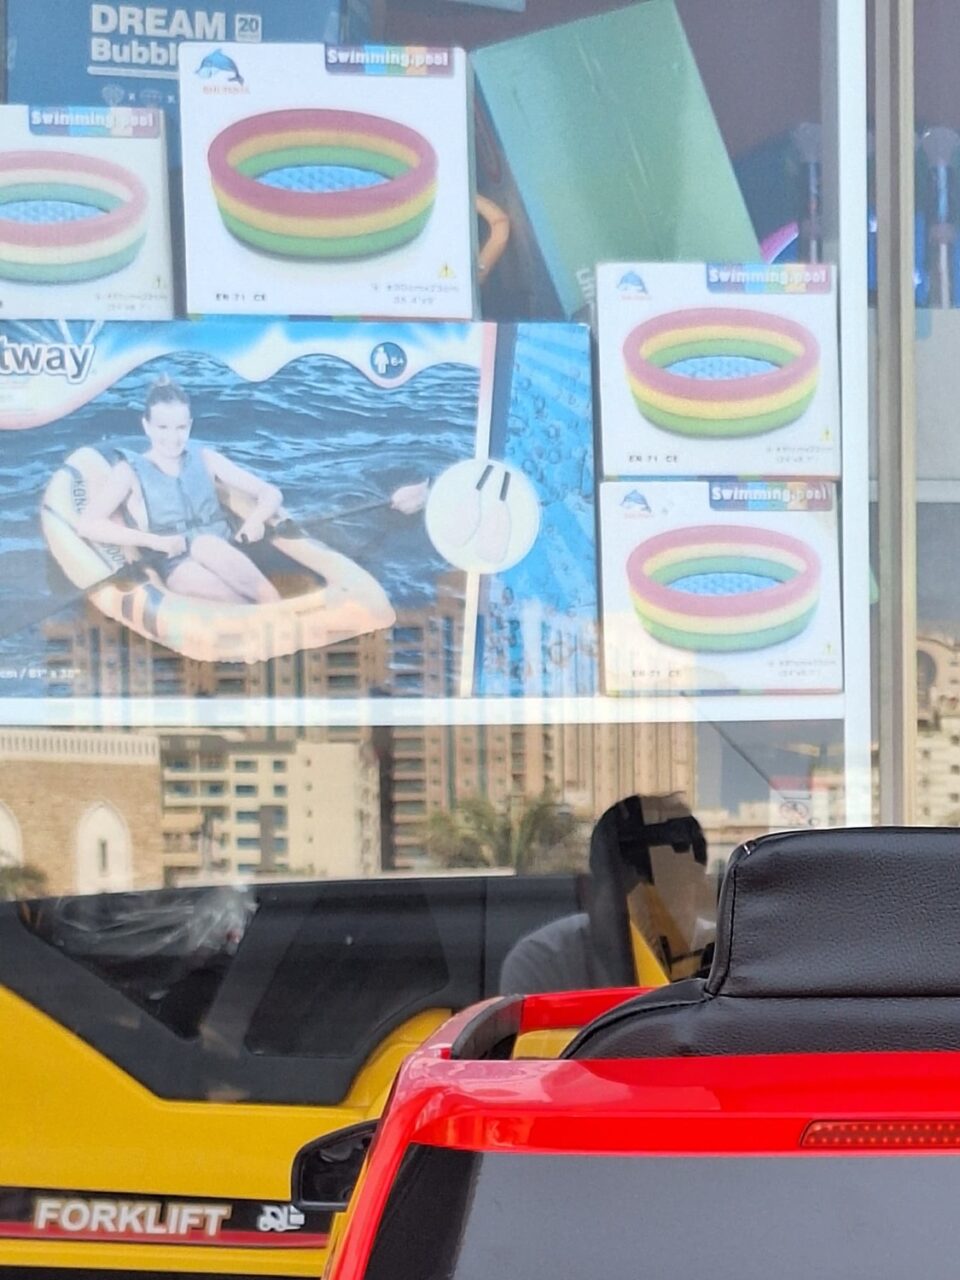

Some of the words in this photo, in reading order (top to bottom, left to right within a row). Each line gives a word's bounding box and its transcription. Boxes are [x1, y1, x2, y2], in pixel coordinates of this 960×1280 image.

[91, 4, 226, 41] DREAM
[238, 17, 259, 33] 20
[36, 1199, 231, 1237] FORKLIFT
